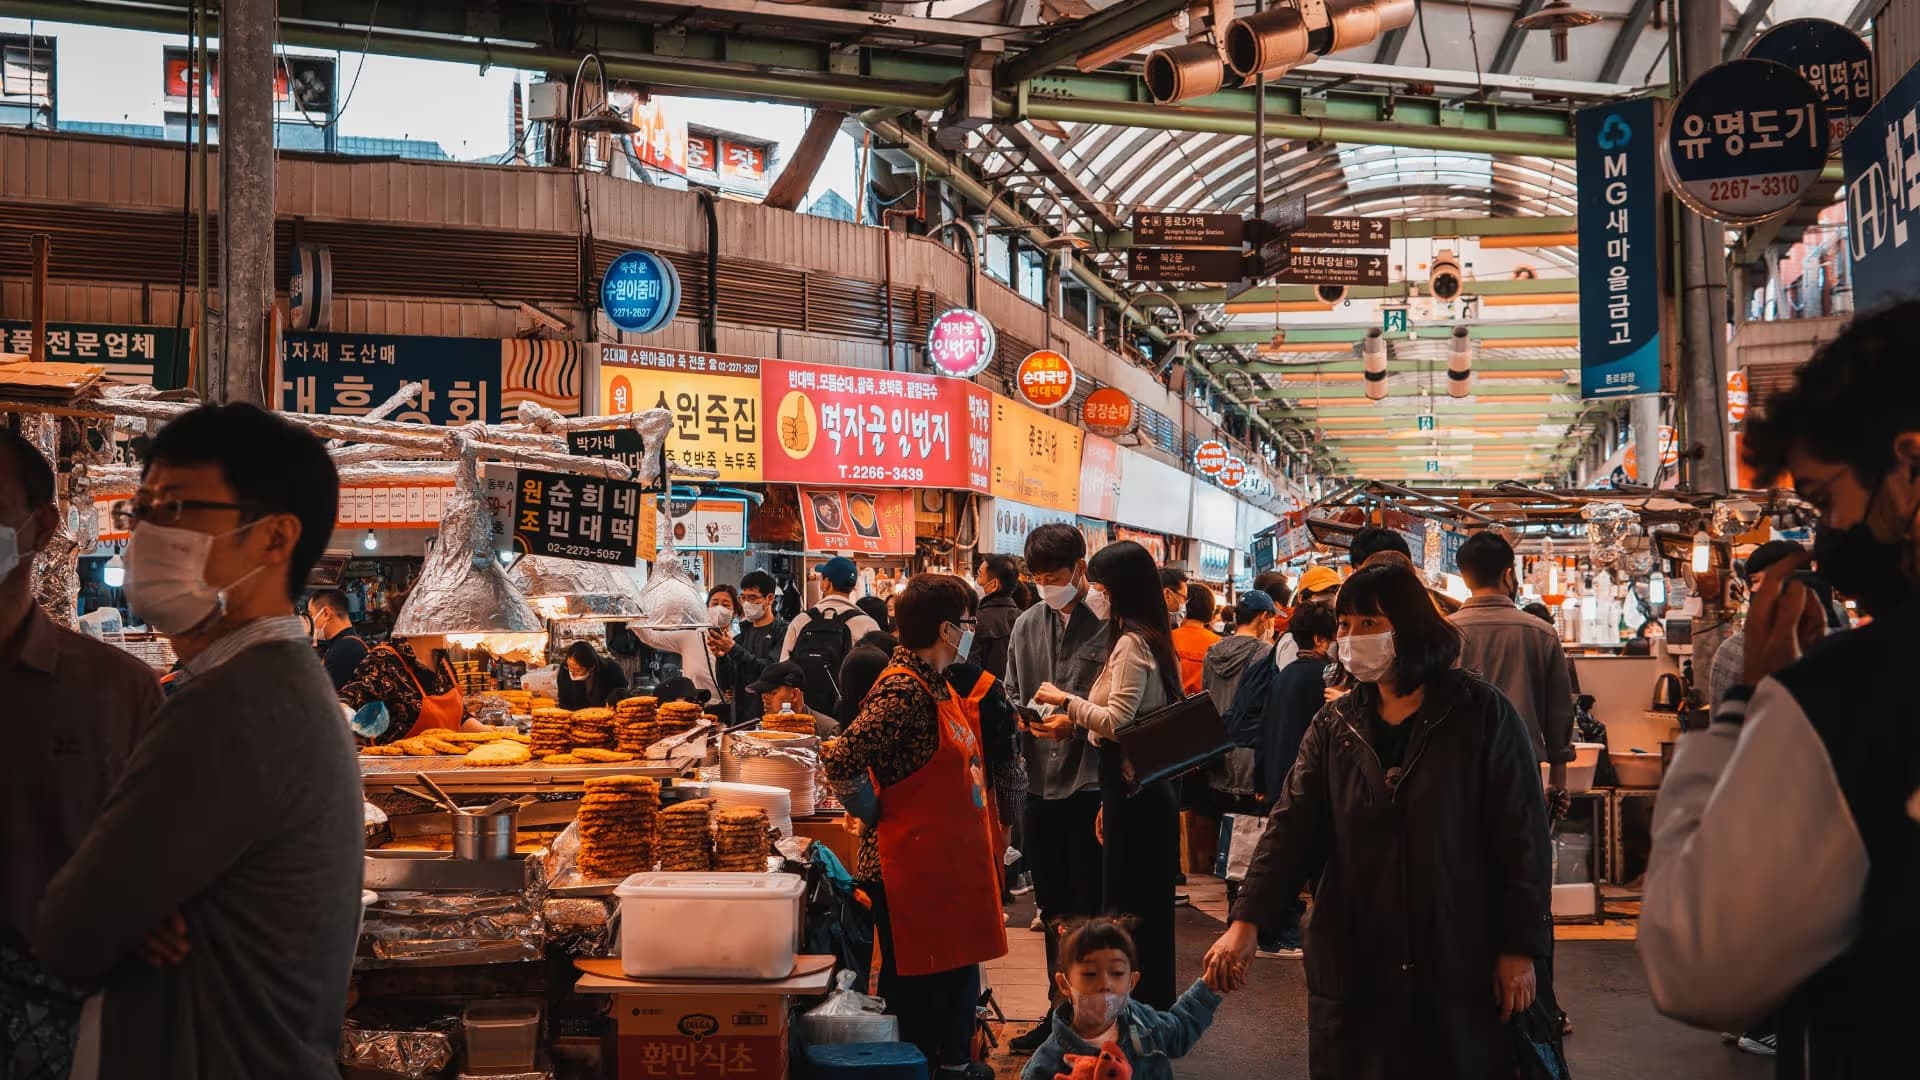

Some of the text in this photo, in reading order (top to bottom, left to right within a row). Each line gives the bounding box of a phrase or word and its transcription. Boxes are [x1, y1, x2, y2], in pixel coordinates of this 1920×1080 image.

[1678, 103, 1818, 160] 유명도기
[1710, 175, 1799, 201] 2267-3310
[1604, 152, 1632, 346] MG새마을금고
[605, 279, 660, 301] 수원아줌마
[0, 329, 155, 359] 품 전문업체
[340, 343, 396, 364] 도산매
[934, 338, 980, 361] 일번지
[603, 347, 628, 363] 2대째
[631, 350, 676, 369] 수원아줌마
[678, 354, 687, 369] 죽
[689, 356, 706, 371] 전문
[1023, 370, 1069, 385] 순대국밥
[1028, 385, 1063, 398] 빈대떡
[1087, 402, 1129, 420] 광장순대
[576, 434, 616, 451] 박가네
[683, 450, 717, 469] 호박죽
[724, 452, 757, 471] 녹두죽
[838, 465, 924, 482] T.2266-3439
[519, 478, 544, 533] 원조
[547, 479, 637, 517] 순희네
[547, 509, 633, 547] 빈대떡
[547, 542, 622, 561] 02-2273-5057
[640, 1041, 757, 1077] 환만식초
